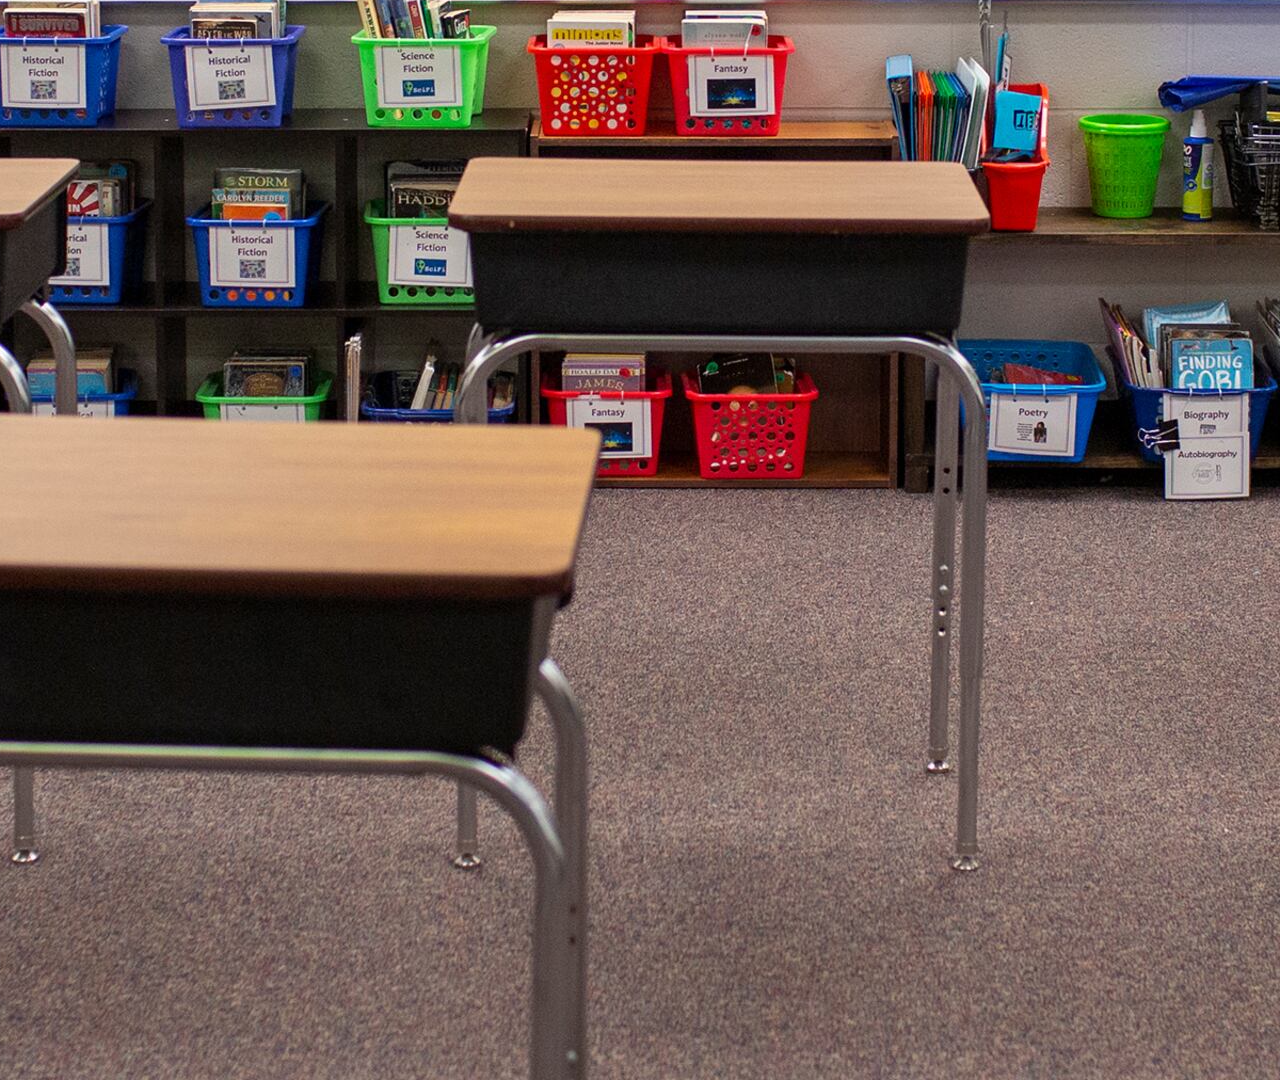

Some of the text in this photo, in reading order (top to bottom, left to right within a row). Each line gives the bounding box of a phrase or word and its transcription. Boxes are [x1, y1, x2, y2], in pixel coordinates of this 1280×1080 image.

[552, 27, 624, 40] minions
[22, 56, 64, 65] Historical
[208, 55, 251, 65] Historical
[401, 52, 435, 60] Science
[28, 68, 59, 77] Fiction
[215, 68, 246, 78] Fiction
[403, 64, 434, 73] Fiction
[714, 63, 748, 74] Fantasy
[238, 176, 288, 187] STORM
[217, 194, 252, 202] CAROLYN
[231, 235, 274, 245] Historical
[415, 230, 449, 240] Science
[238, 247, 268, 257] Fiction
[416, 243, 447, 253] Fiction
[1178, 355, 1243, 371] FINDING
[576, 378, 625, 390] JAMES
[1178, 369, 1241, 389] GOBI
[591, 407, 626, 418] Fantasy
[1018, 407, 1049, 419] Poetry
[1183, 410, 1230, 421] Biography
[1177, 449, 1238, 460] Autobiography
